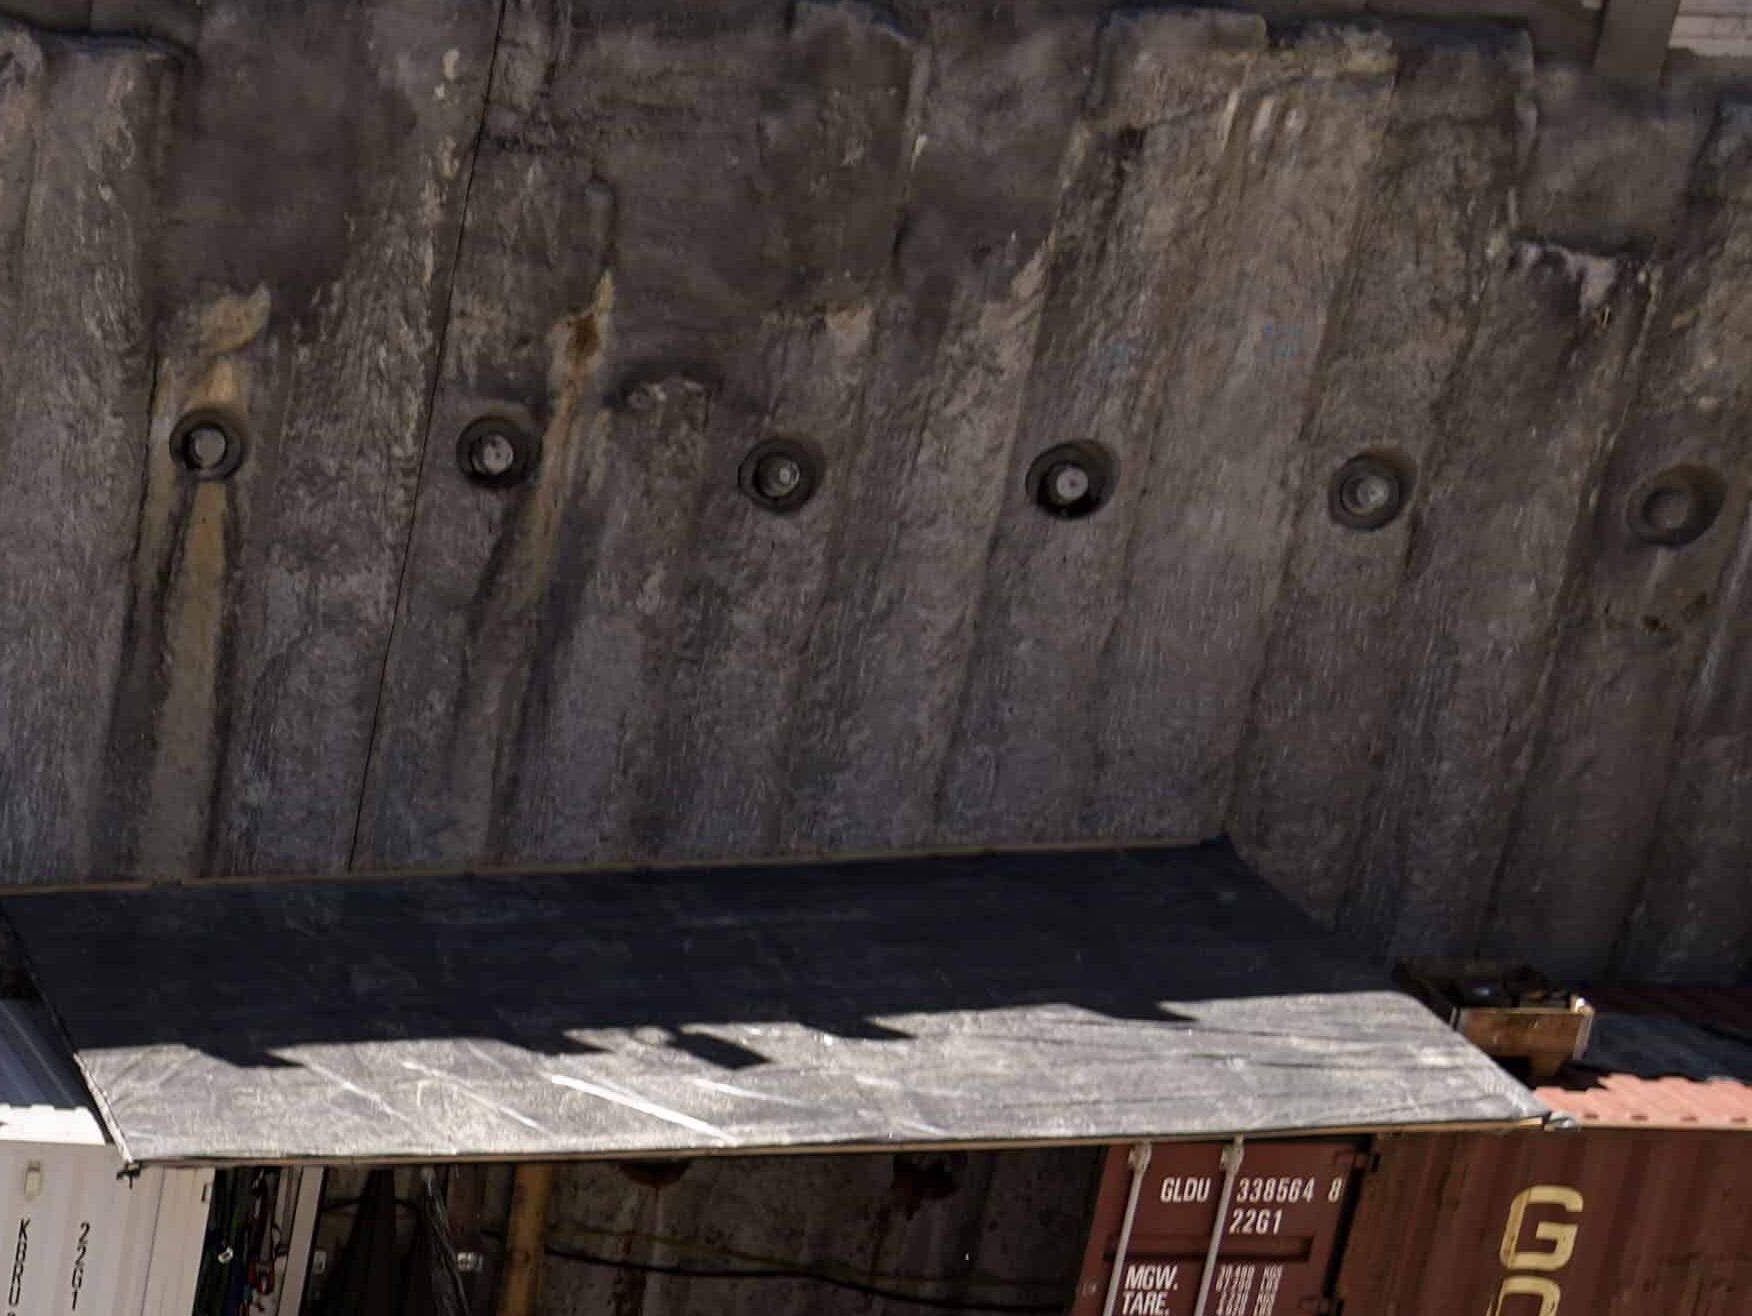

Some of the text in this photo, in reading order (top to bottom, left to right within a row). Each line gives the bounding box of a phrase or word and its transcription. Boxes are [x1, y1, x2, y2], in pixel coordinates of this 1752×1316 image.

[1161, 1177, 1343, 1203] GLDU 338564 8
[1229, 1209, 1283, 1234] 22G1
[71, 1221, 90, 1311] 22G1
[1125, 1265, 1178, 1290] MGW.
[1122, 1292, 1169, 1316] TARE.
